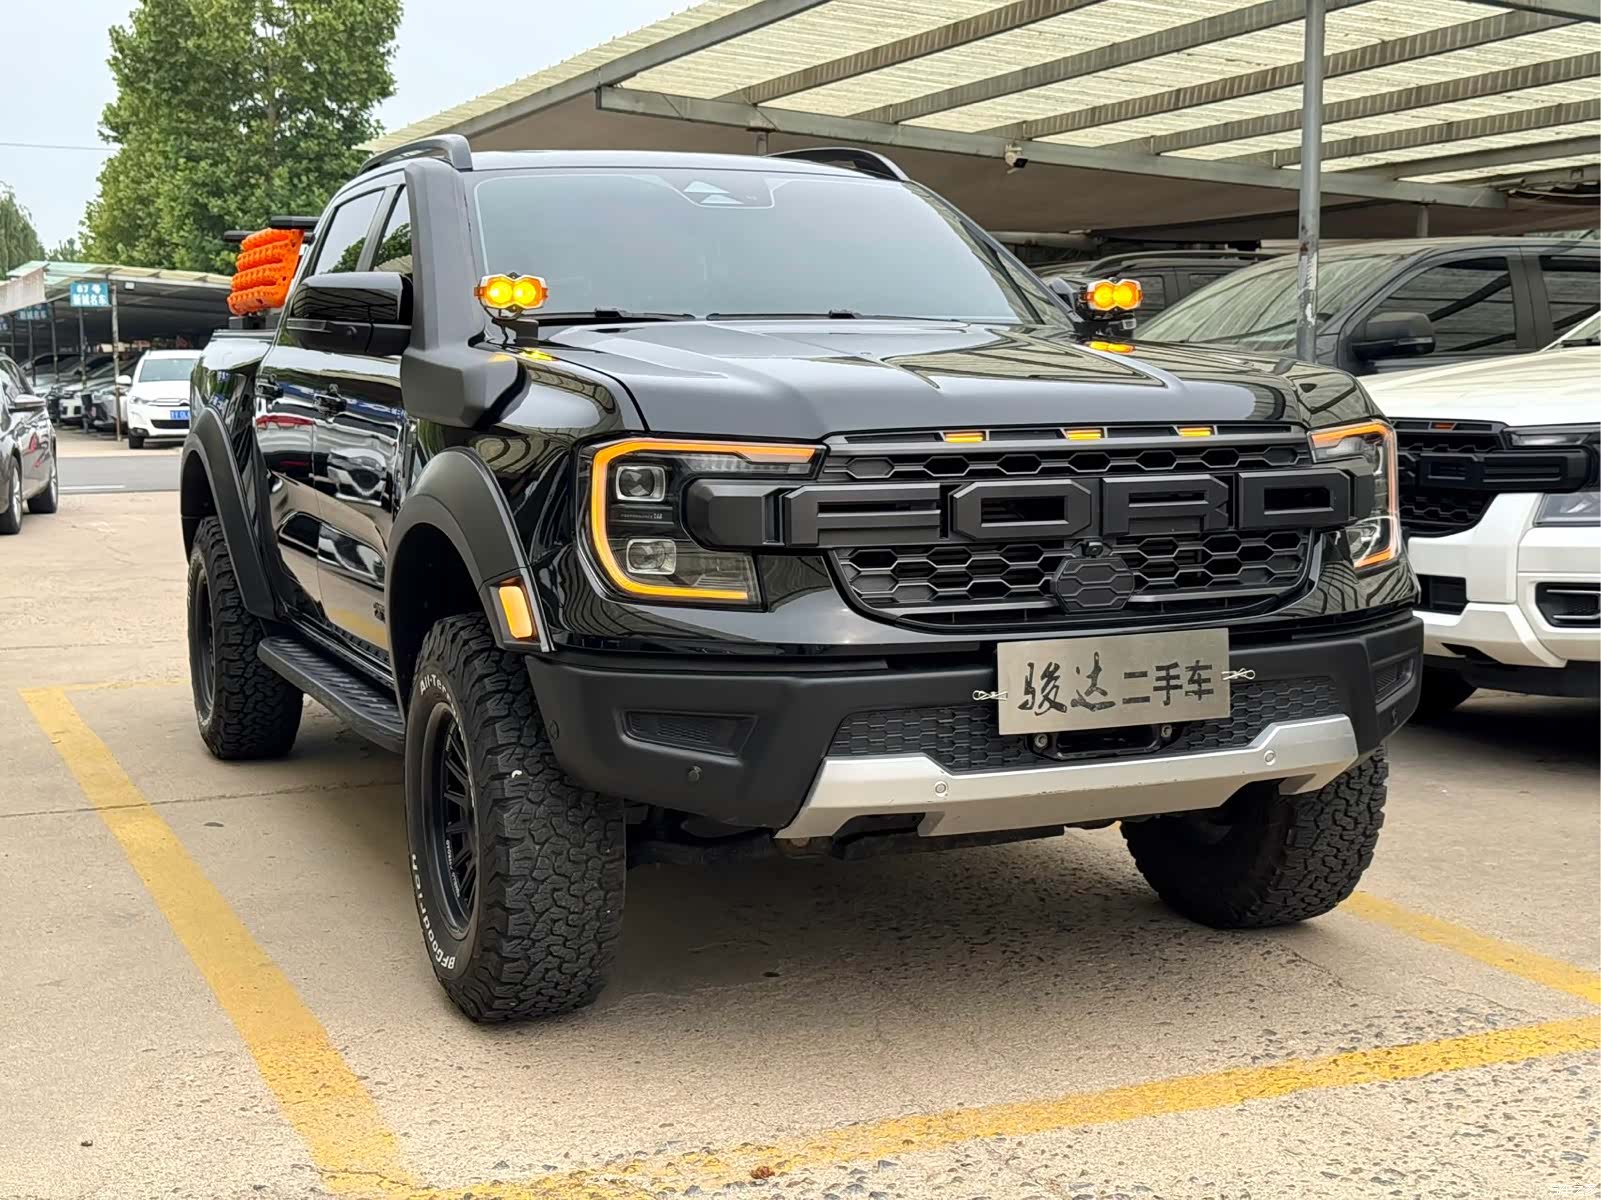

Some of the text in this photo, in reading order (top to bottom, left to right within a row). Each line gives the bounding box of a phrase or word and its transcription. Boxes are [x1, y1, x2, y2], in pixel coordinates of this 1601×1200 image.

[783, 469, 1354, 547] FORD
[1017, 651, 1214, 716] 骏达二手车
